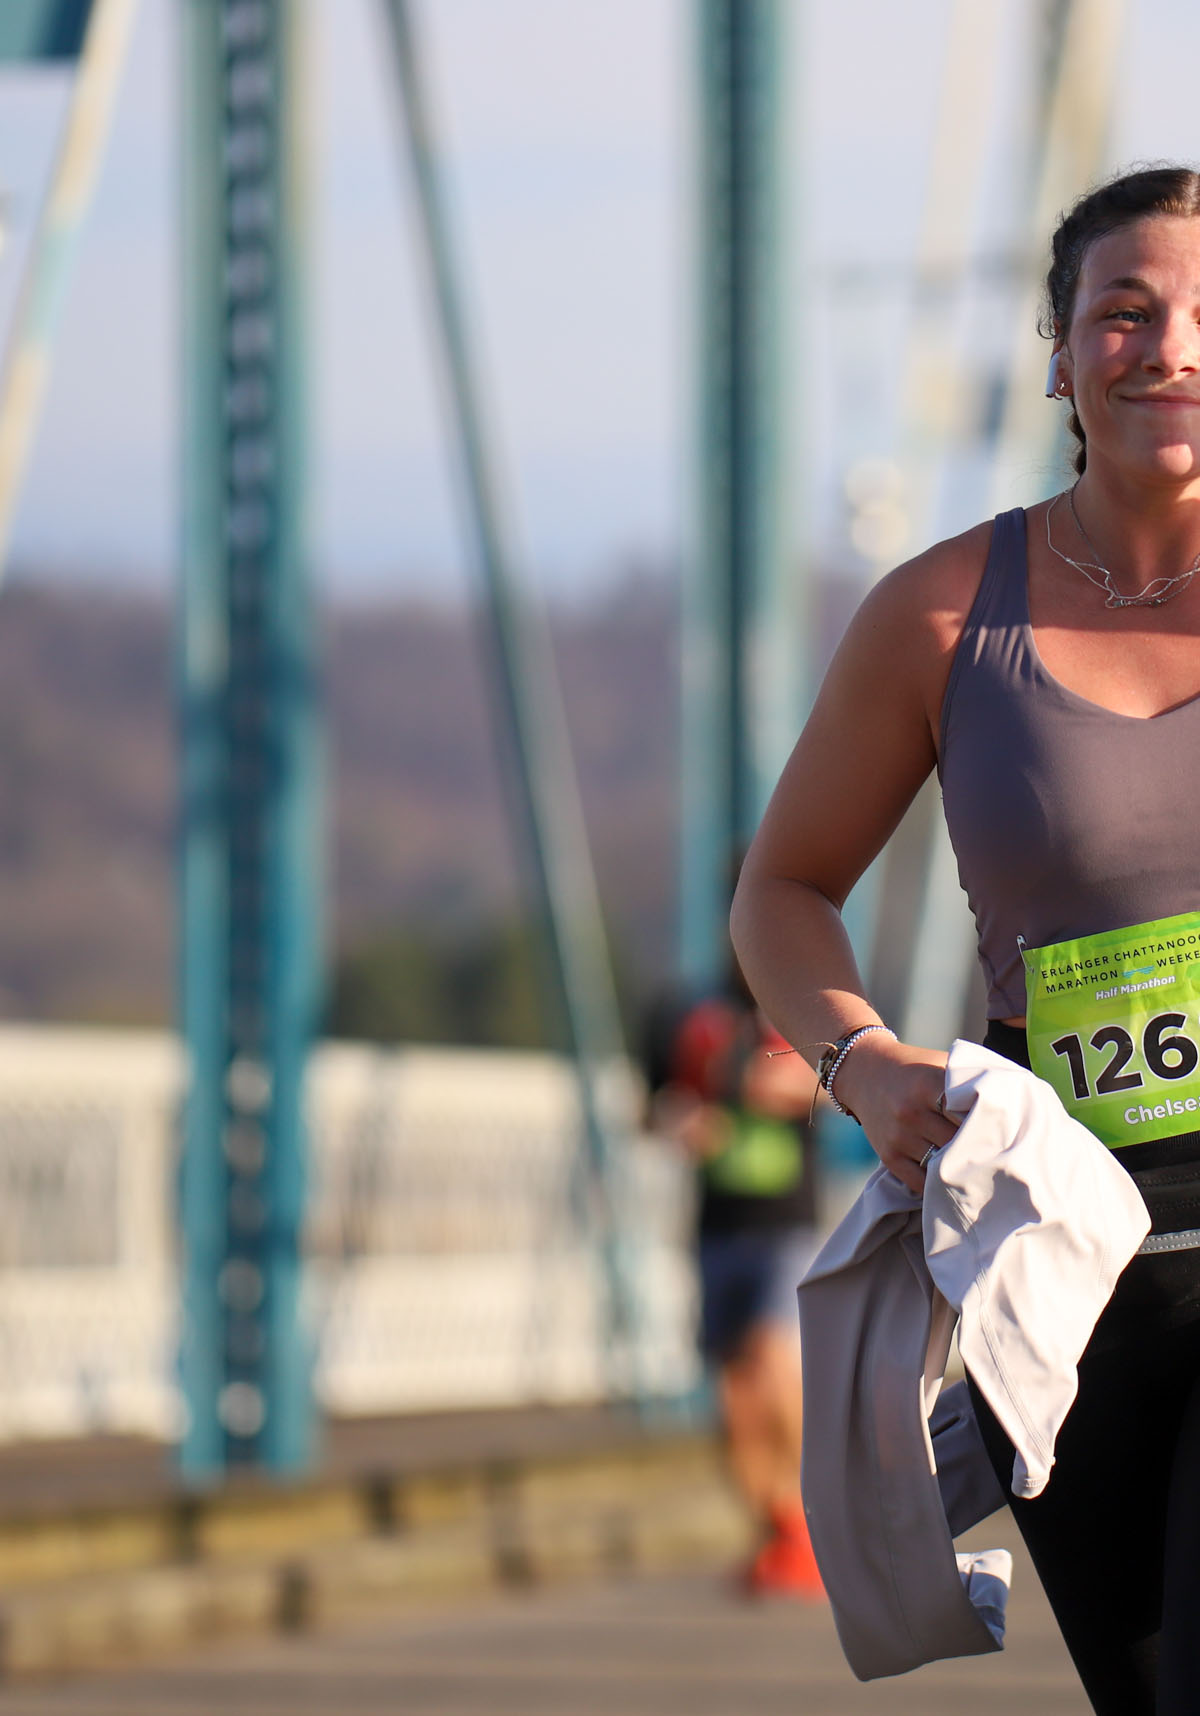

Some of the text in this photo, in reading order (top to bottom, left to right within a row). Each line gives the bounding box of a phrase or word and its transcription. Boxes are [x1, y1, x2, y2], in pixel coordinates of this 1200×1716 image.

[1041, 956, 1110, 979] ERLANGER
[1046, 970, 1119, 994] MARATHON
[1095, 975, 1176, 1000] Half Marathon
